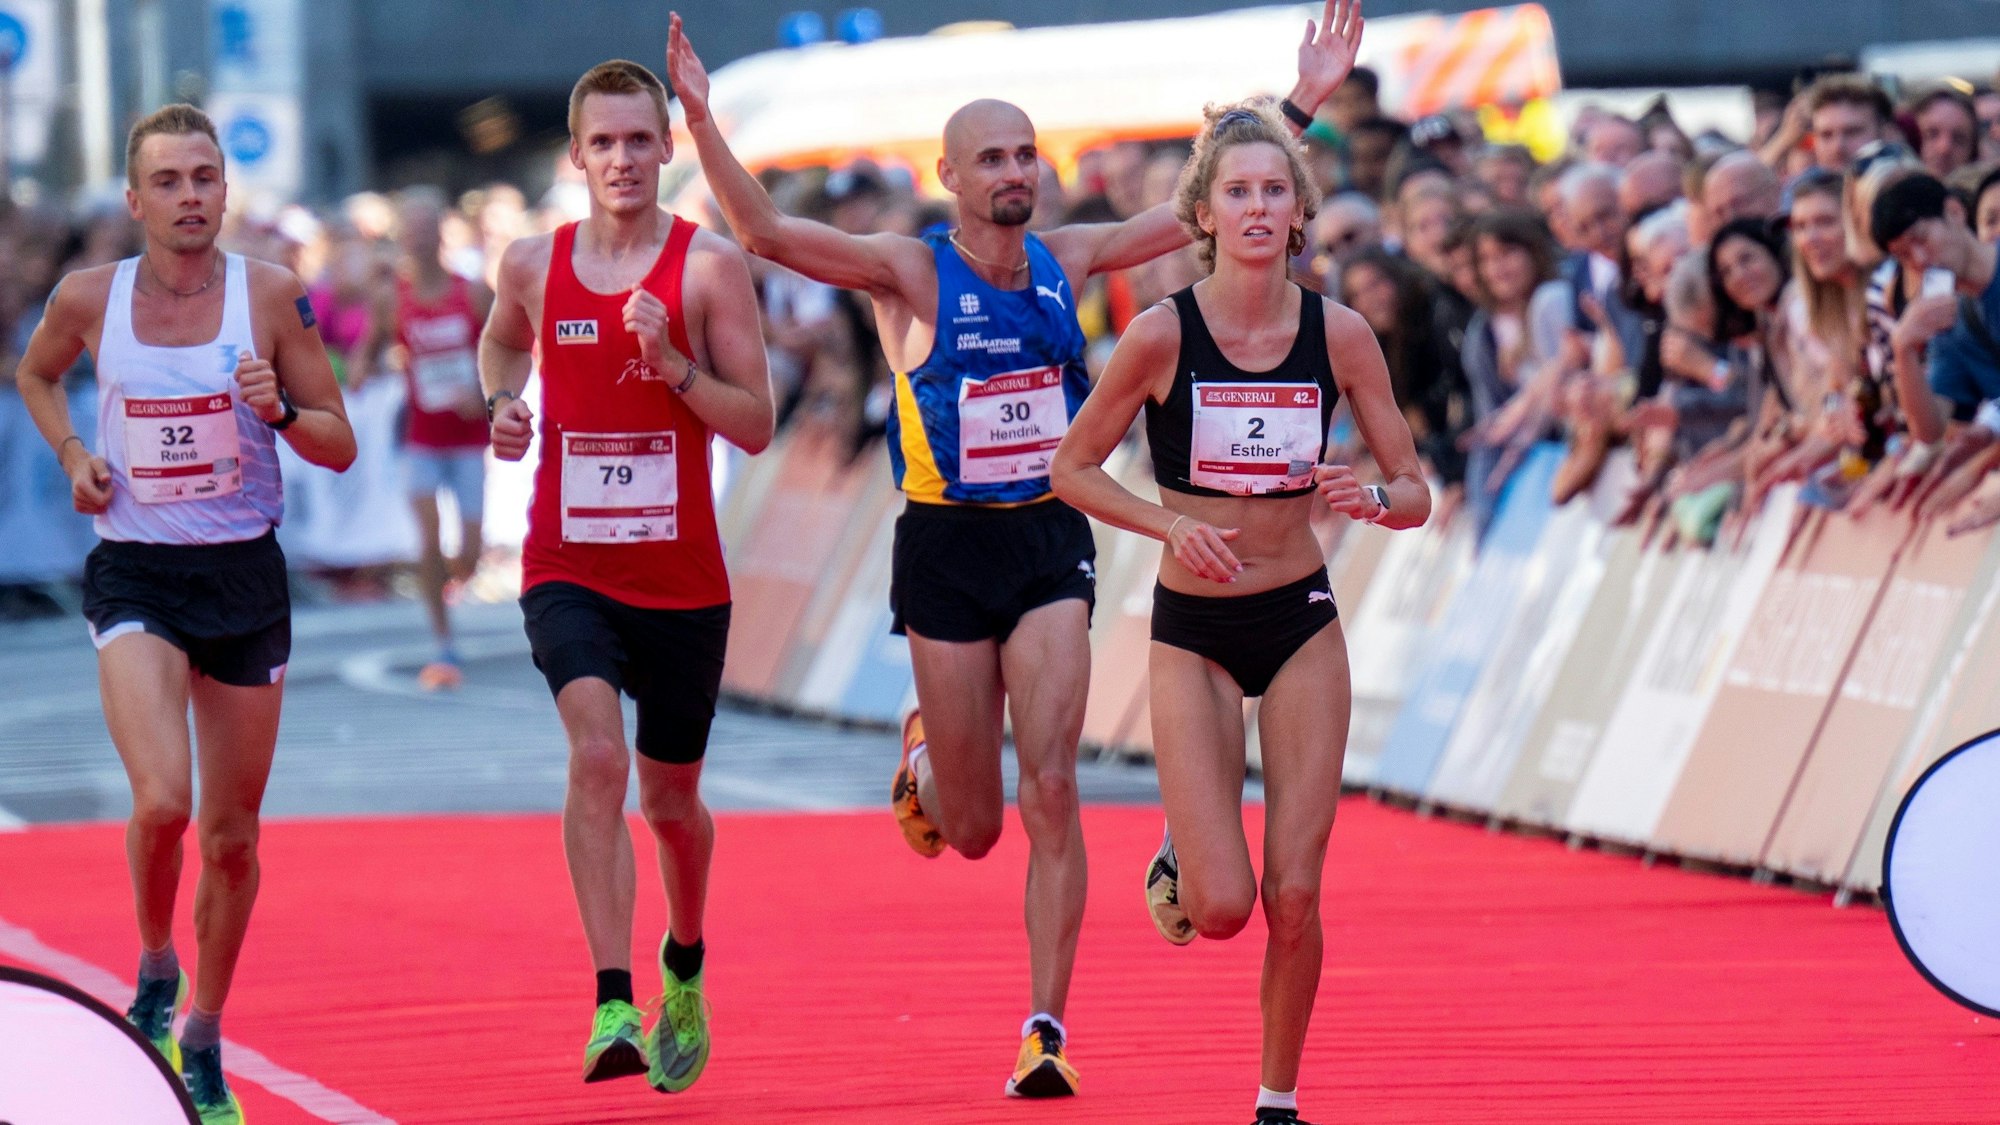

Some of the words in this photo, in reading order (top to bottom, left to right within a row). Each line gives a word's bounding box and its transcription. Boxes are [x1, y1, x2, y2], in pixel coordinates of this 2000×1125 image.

[558, 323, 596, 336] NTA
[957, 332, 981, 340] ADAC
[967, 338, 1021, 349] MARATHON
[983, 378, 1030, 393] GENERALI
[1222, 391, 1276, 403] GENERALI
[143, 402, 193, 415] GENERALI
[1000, 401, 1031, 423] 30
[990, 424, 1041, 441] Hendrik
[1247, 417, 1265, 439] 2
[161, 425, 195, 446] 32
[584, 441, 634, 453] GENERALI
[1231, 443, 1281, 457] Esther
[161, 448, 198, 462] René
[599, 465, 633, 486] 79
